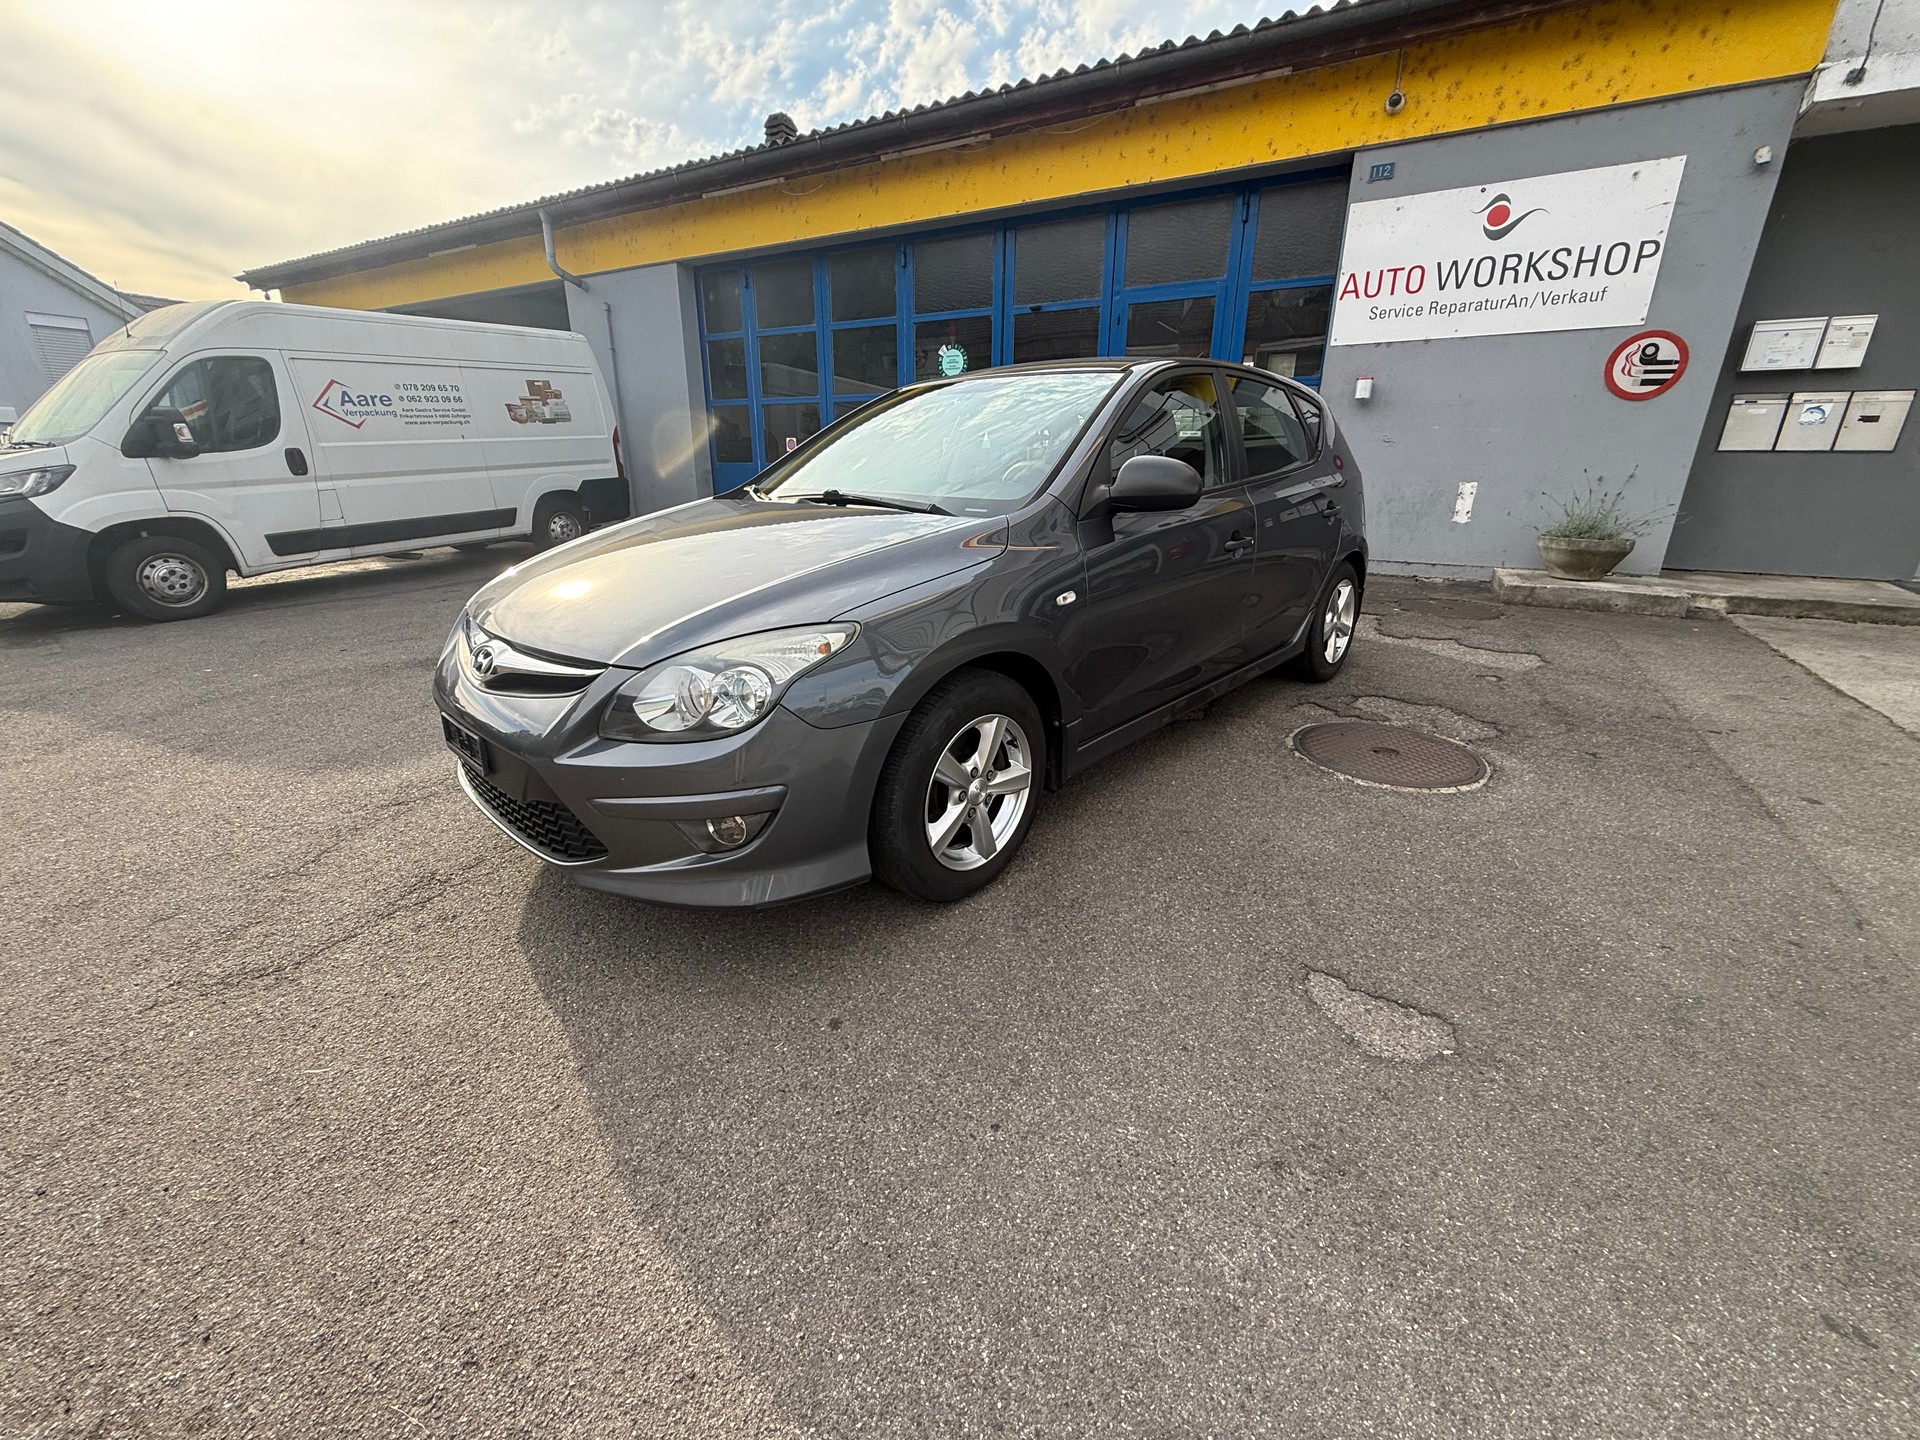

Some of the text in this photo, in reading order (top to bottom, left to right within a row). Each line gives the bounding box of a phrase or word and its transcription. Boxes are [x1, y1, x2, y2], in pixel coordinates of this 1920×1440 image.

[1373, 165, 1391, 178] 112
[1339, 239, 1661, 301] AUTO WORKSHOP
[1369, 303, 1423, 320] Service
[402, 383, 419, 391] 078
[420, 384, 436, 392] 209
[437, 384, 448, 392] 65
[340, 390, 393, 407] Aare
[406, 395, 422, 403] 062
[424, 395, 440, 403] 923
[342, 408, 398, 418] Verpackung
